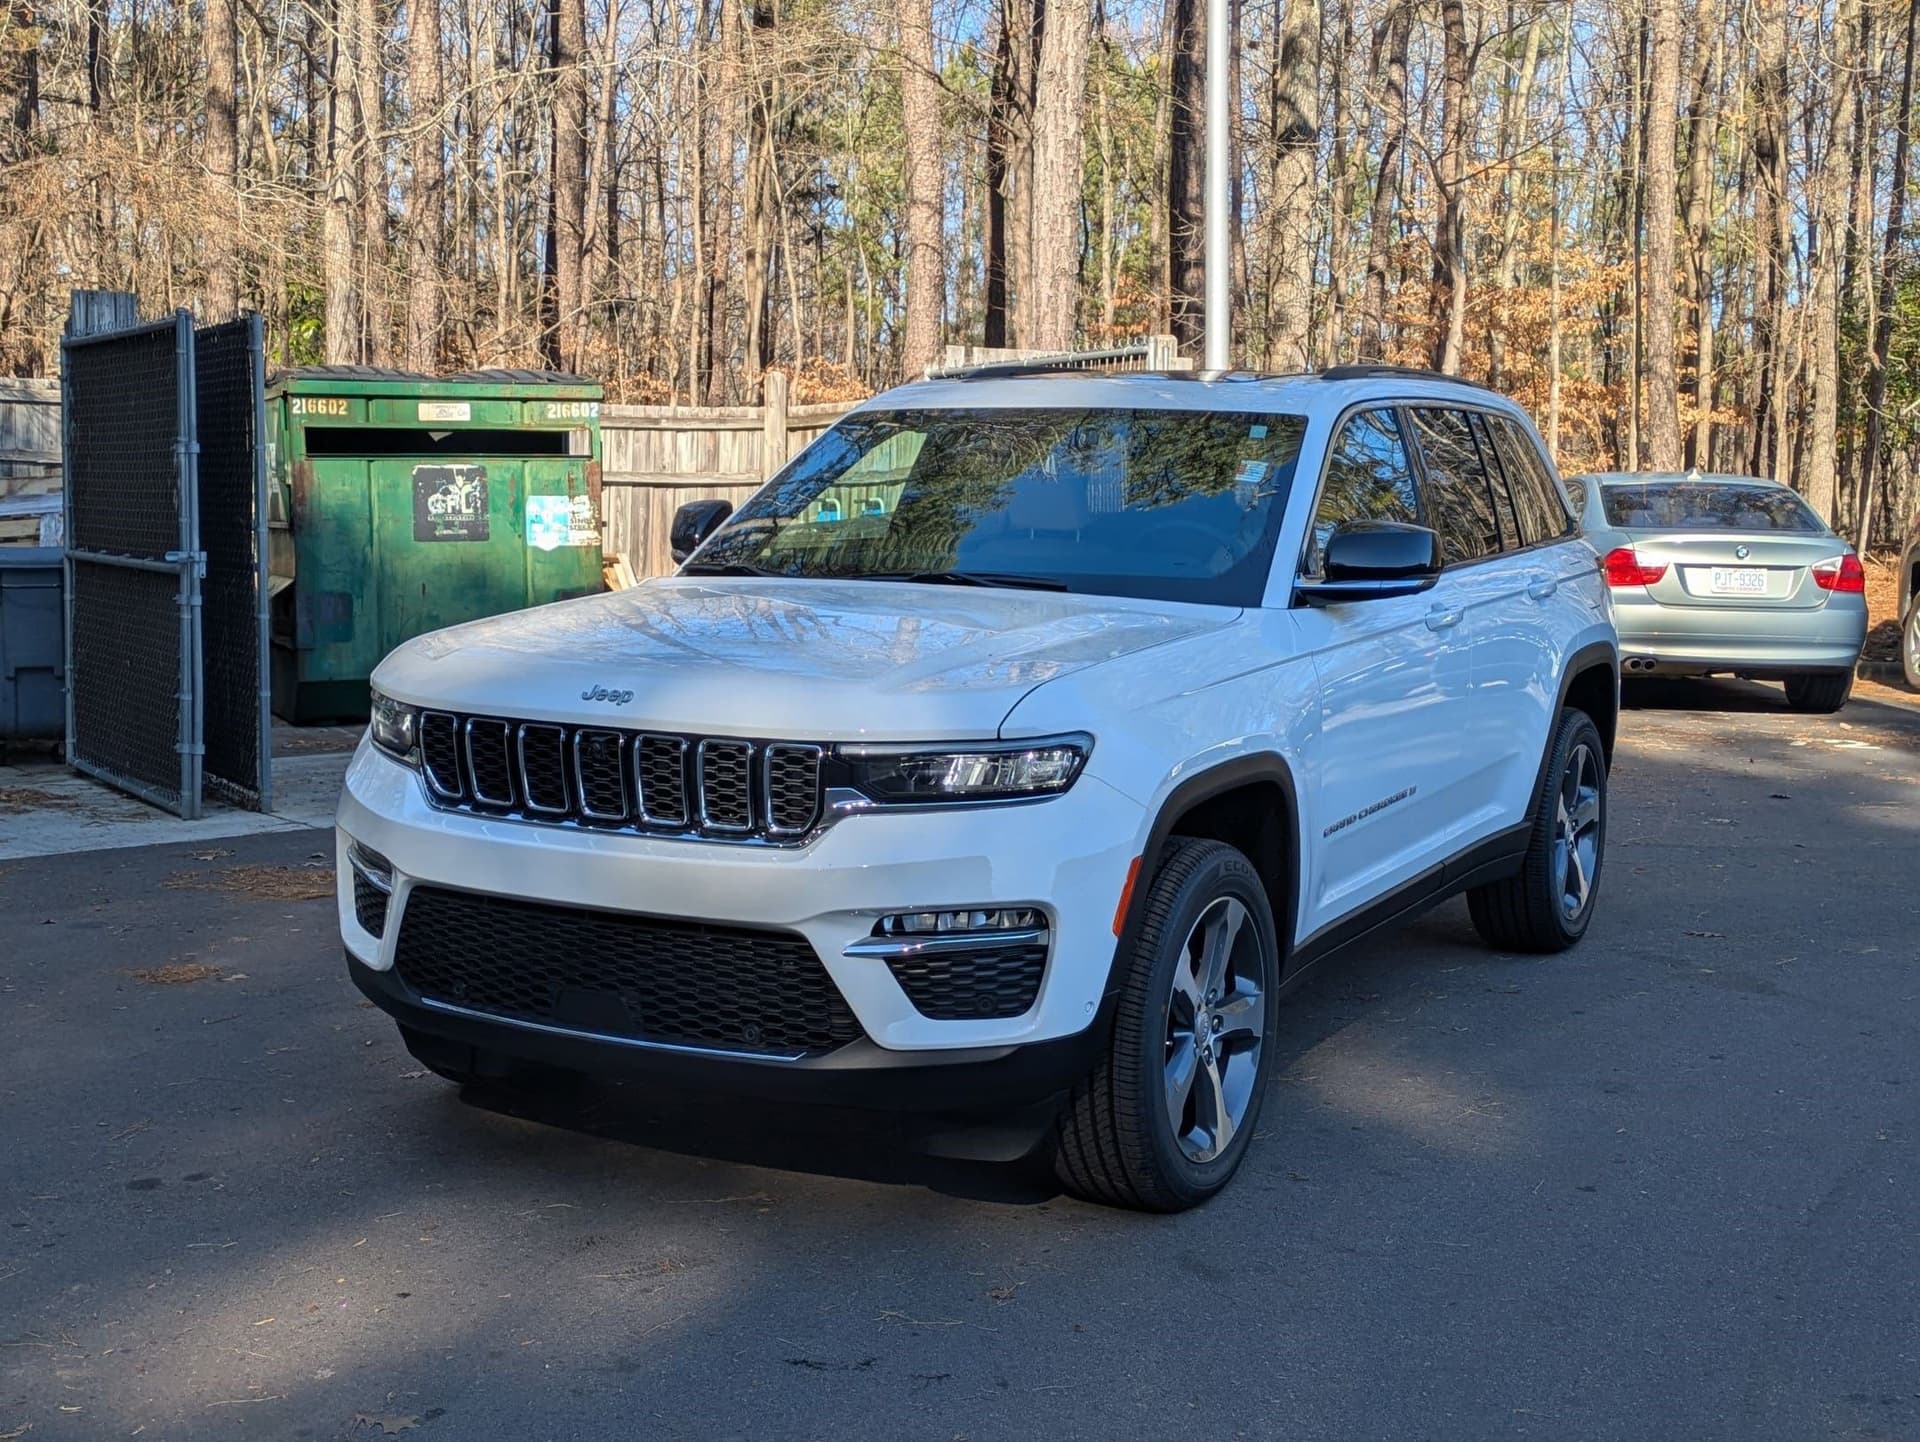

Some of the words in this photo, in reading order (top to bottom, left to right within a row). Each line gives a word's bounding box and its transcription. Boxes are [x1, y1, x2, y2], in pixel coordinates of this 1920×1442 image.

[292, 398, 348, 415] 216602
[547, 402, 599, 418] 216602
[1715, 572, 1764, 587] PJT-9326
[581, 684, 634, 706] Jeep
